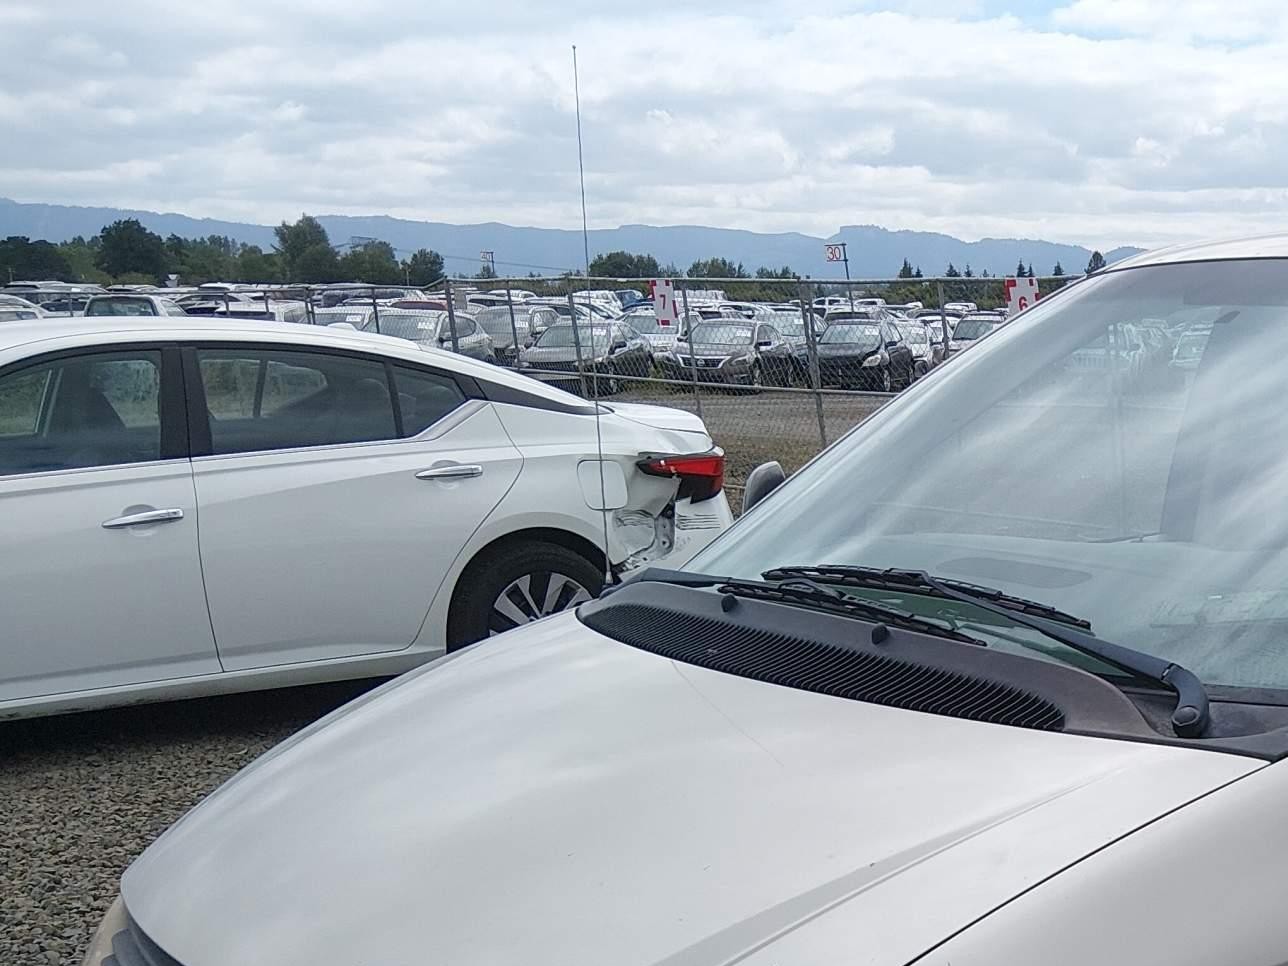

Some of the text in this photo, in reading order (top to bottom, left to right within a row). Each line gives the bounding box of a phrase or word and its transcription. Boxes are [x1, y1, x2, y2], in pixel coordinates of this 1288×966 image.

[827, 246, 841, 260] 30
[659, 294, 666, 310] 7
[1018, 296, 1029, 311] 6
